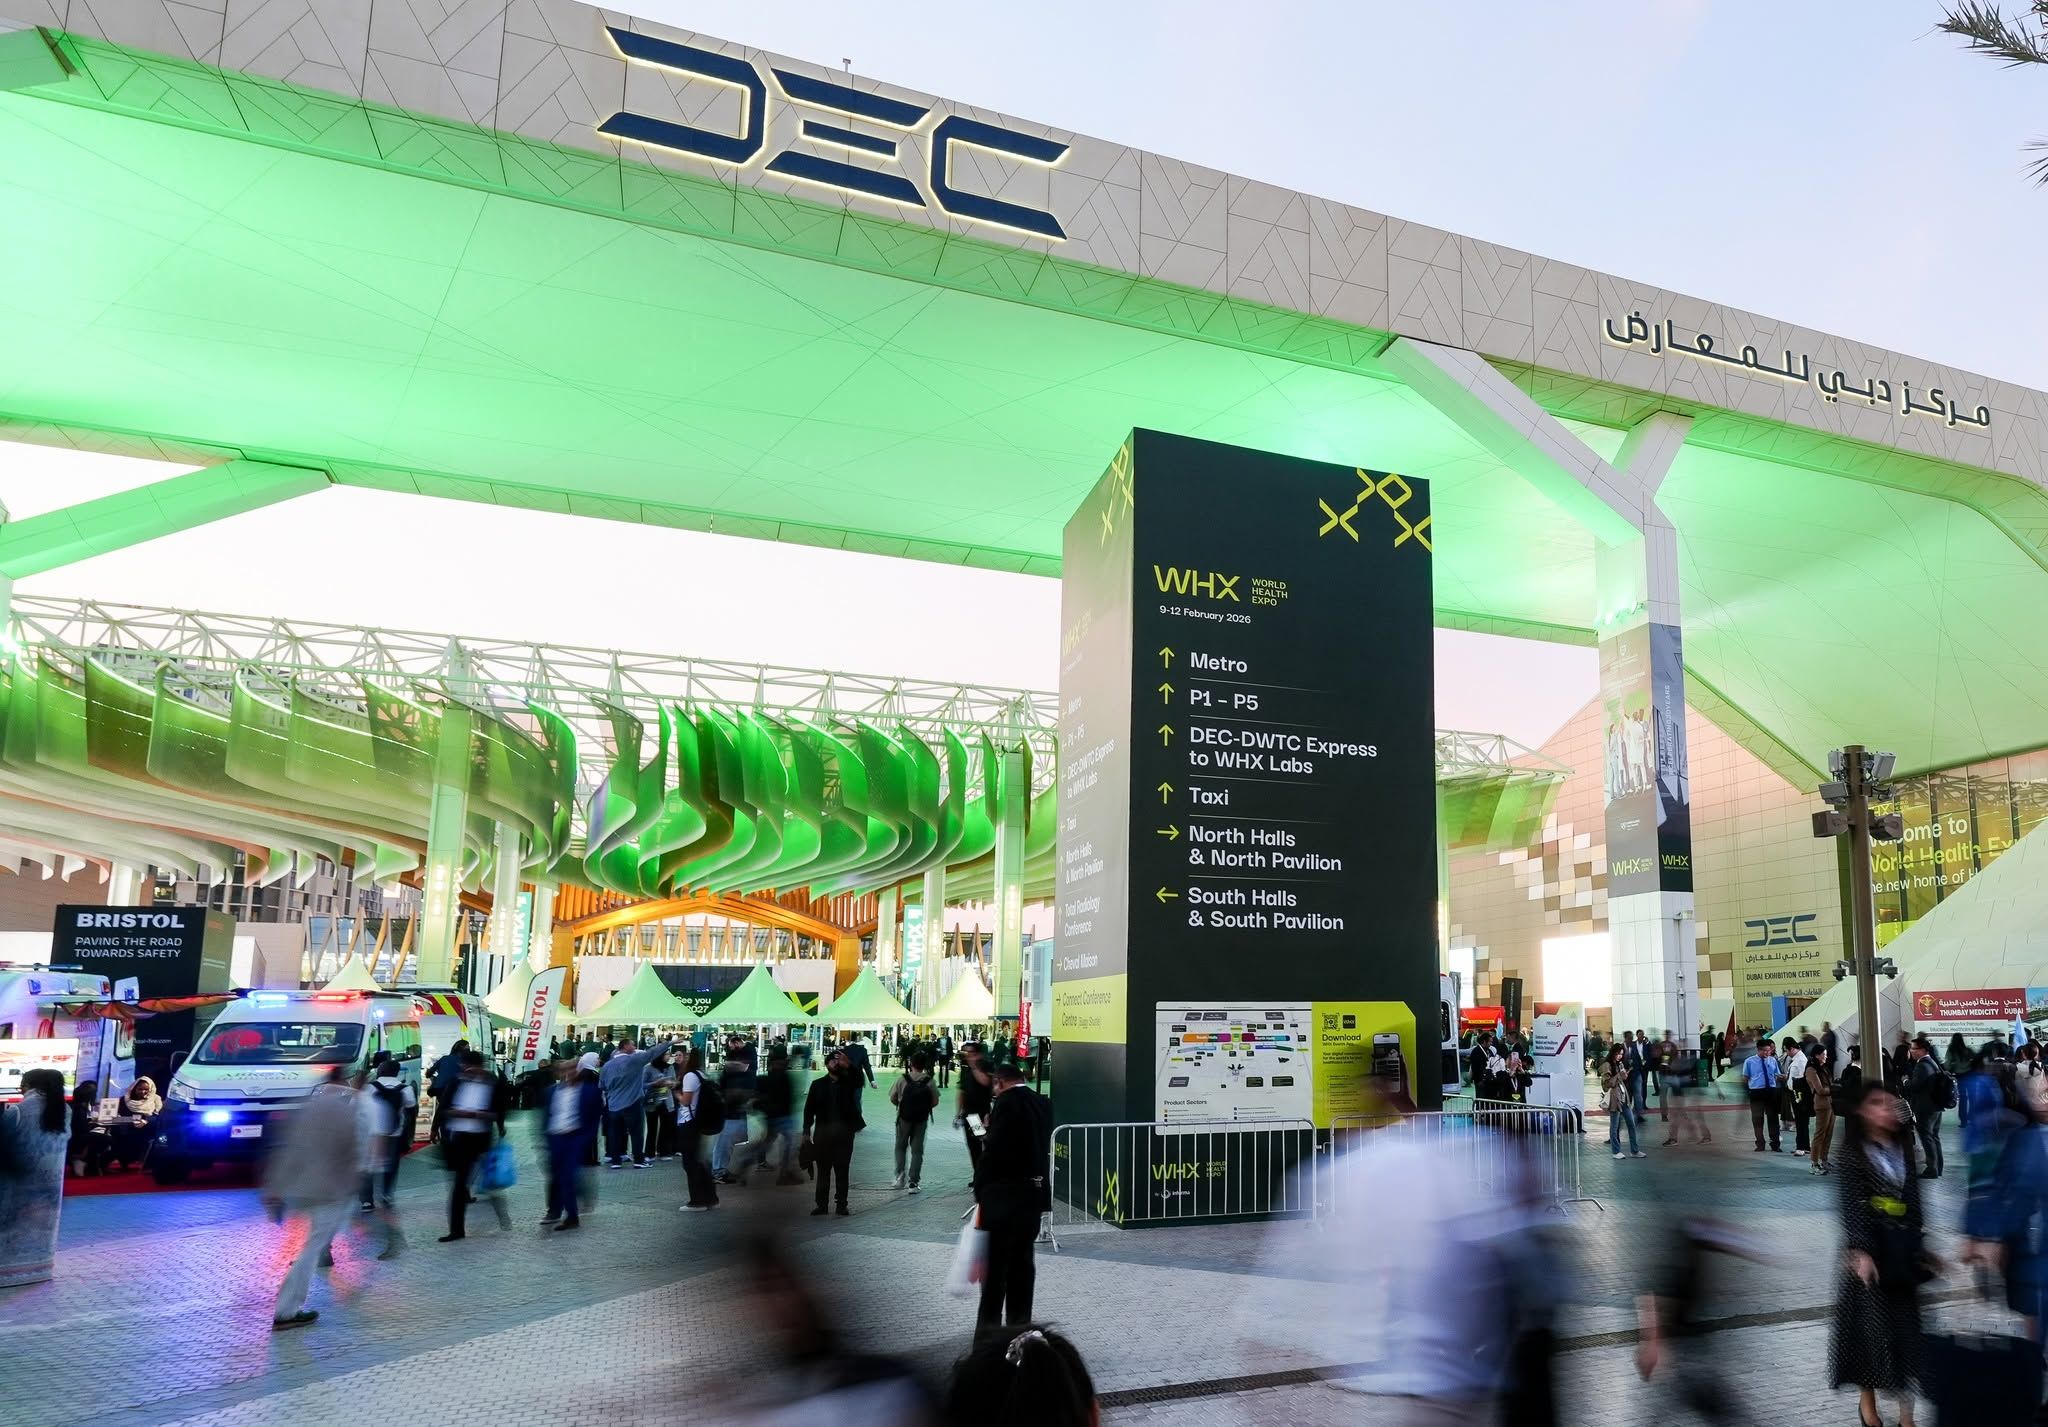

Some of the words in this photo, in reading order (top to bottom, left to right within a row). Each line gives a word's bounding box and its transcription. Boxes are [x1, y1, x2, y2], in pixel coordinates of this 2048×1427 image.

[597, 25, 1071, 241] DEC
[1605, 312, 1809, 383] للمعارض
[1817, 371, 1892, 406] دبي
[1901, 380, 1990, 427] مركز
[1153, 564, 1241, 602] WHX
[1251, 578, 1287, 590] WORLD
[1251, 587, 1288, 599] HEALTH
[1251, 596, 1278, 607] EXPO
[1159, 605, 1181, 616] 9-12
[1183, 608, 1224, 623] February
[1226, 613, 1252, 624] 2026
[1189, 652, 1248, 673] Metro
[1189, 689, 1212, 707] P1
[1233, 693, 1259, 711] P5
[1094, 738, 1115, 762] Express
[1189, 726, 1301, 752] DEC-DWTC
[1305, 736, 1378, 759] Express
[1189, 750, 1209, 766] to
[1214, 751, 1265, 771] WHX
[1269, 755, 1314, 774] Labs
[1188, 786, 1229, 806] Taxi
[1067, 815, 1077, 831] Taxi
[1948, 817, 1968, 835] to
[1189, 825, 1245, 845] North
[1250, 828, 1297, 847] Halls
[1065, 846, 1079, 865] North
[1079, 841, 1092, 860] Halls
[1188, 848, 1205, 865] &
[1210, 849, 1266, 868] North
[1271, 852, 1343, 871] Pavilion
[1662, 854, 1689, 866] WHX
[1920, 840, 1982, 867] Health
[1988, 836, 2018, 857] Ex
[1070, 867, 1084, 883] North
[1084, 858, 1104, 877] Pavilion
[1612, 858, 1641, 877] WHX
[1886, 878, 1910, 892] new
[1914, 873, 1948, 889] home
[1952, 869, 1965, 883] of
[1065, 900, 1076, 917] Total
[1076, 895, 1100, 913] Radiology
[1188, 886, 1246, 905] South
[1251, 889, 1298, 907] Halls
[76, 913, 185, 929] BRISTOL
[1064, 919, 1092, 937] Conference
[1188, 910, 1204, 927] &
[1210, 910, 1268, 929] South
[1272, 912, 1344, 931] Pavilion
[1744, 913, 1818, 947] DEC
[75, 936, 120, 946] PAVING
[123, 937, 147, 946] THE
[149, 937, 183, 947] ROAD
[74, 948, 135, 958] TOWARDS
[137, 948, 181, 958] SAFETY
[1745, 952, 1782, 963] للمعارض
[1781, 952, 1798, 962] دبي
[1799, 950, 1820, 961] مركز
[1746, 973, 1763, 981] DUBAI
[1764, 971, 1797, 980] EXHIBITION
[1798, 969, 1821, 978] CENTRE
[694, 997, 712, 1006] you
[1082, 989, 1111, 1005] Conference
[2003, 998, 2022, 1008] دبي
[1939, 1008, 1968, 1017] THUMBAY
[1968, 1008, 1999, 1016] MEDICITY
[2004, 1007, 2024, 1015] DUBAI
[522, 986, 549, 1061] BRISTOL
[1322, 1033, 1361, 1042] Download
[1152, 1163, 1200, 1180] WHX
